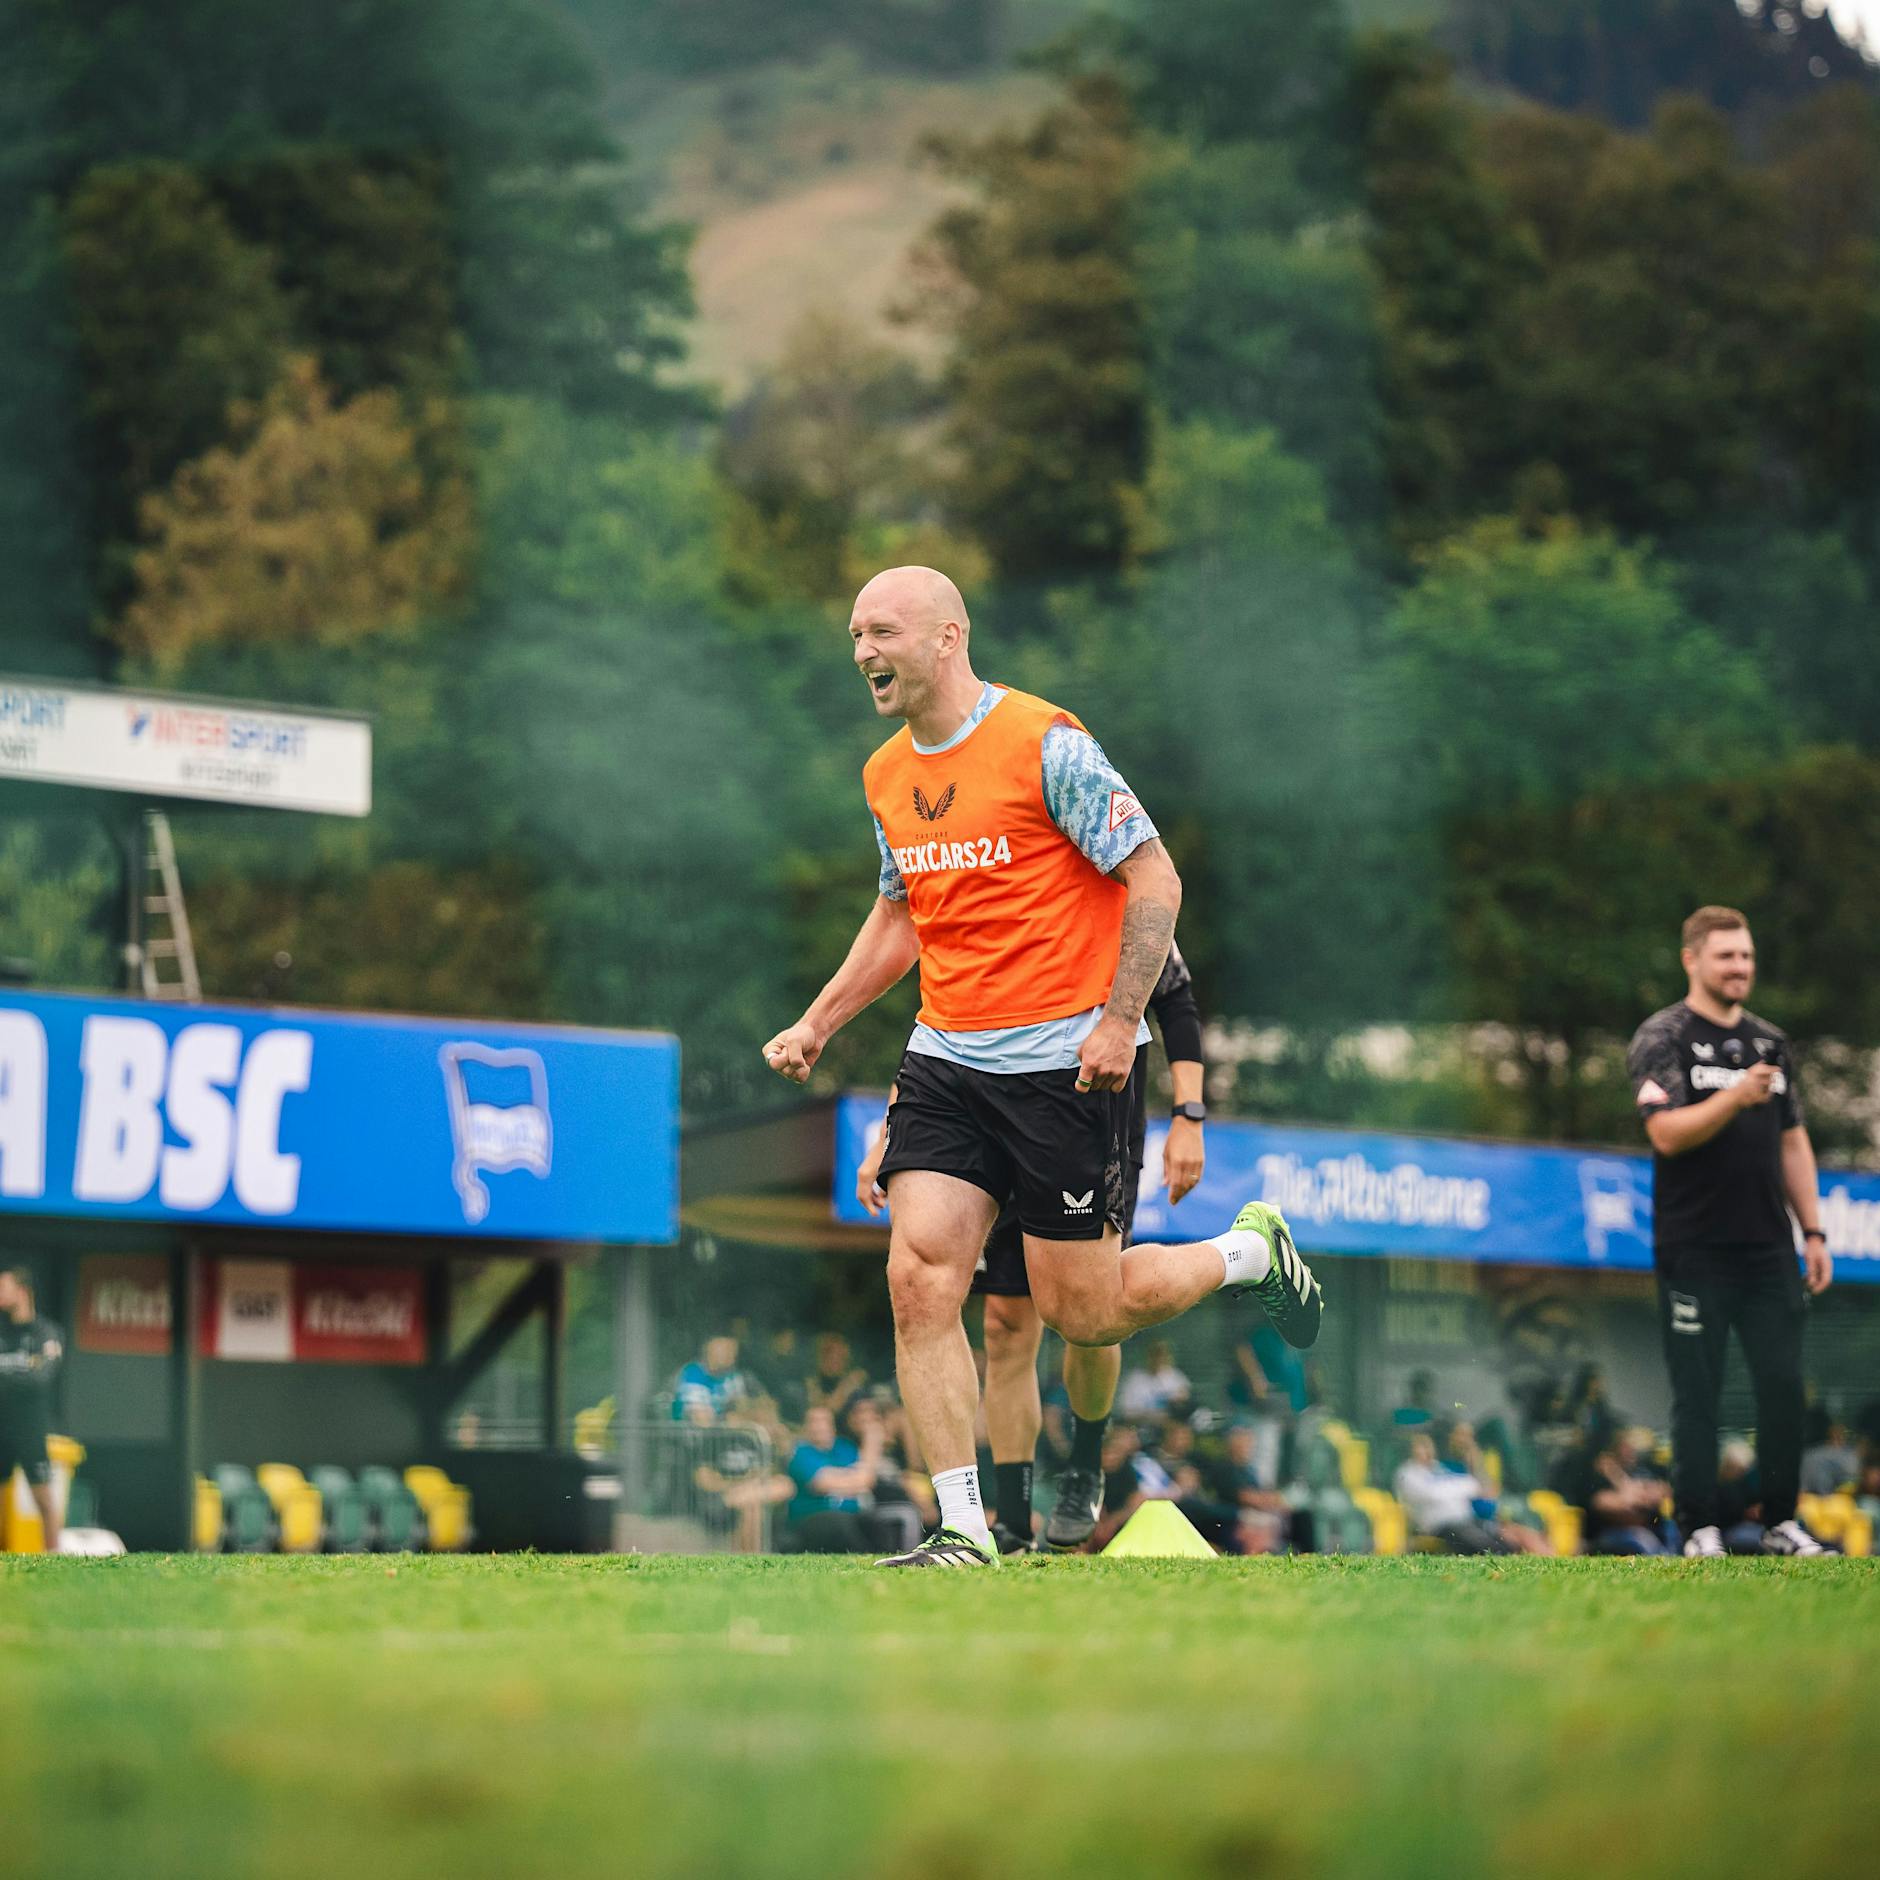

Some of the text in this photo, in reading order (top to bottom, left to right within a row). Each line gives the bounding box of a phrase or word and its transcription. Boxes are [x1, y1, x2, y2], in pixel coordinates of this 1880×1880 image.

[72, 1014, 313, 1216] BSC
[1063, 1207, 1093, 1215] CASTORE
[965, 1471, 978, 1506] CASTORE
